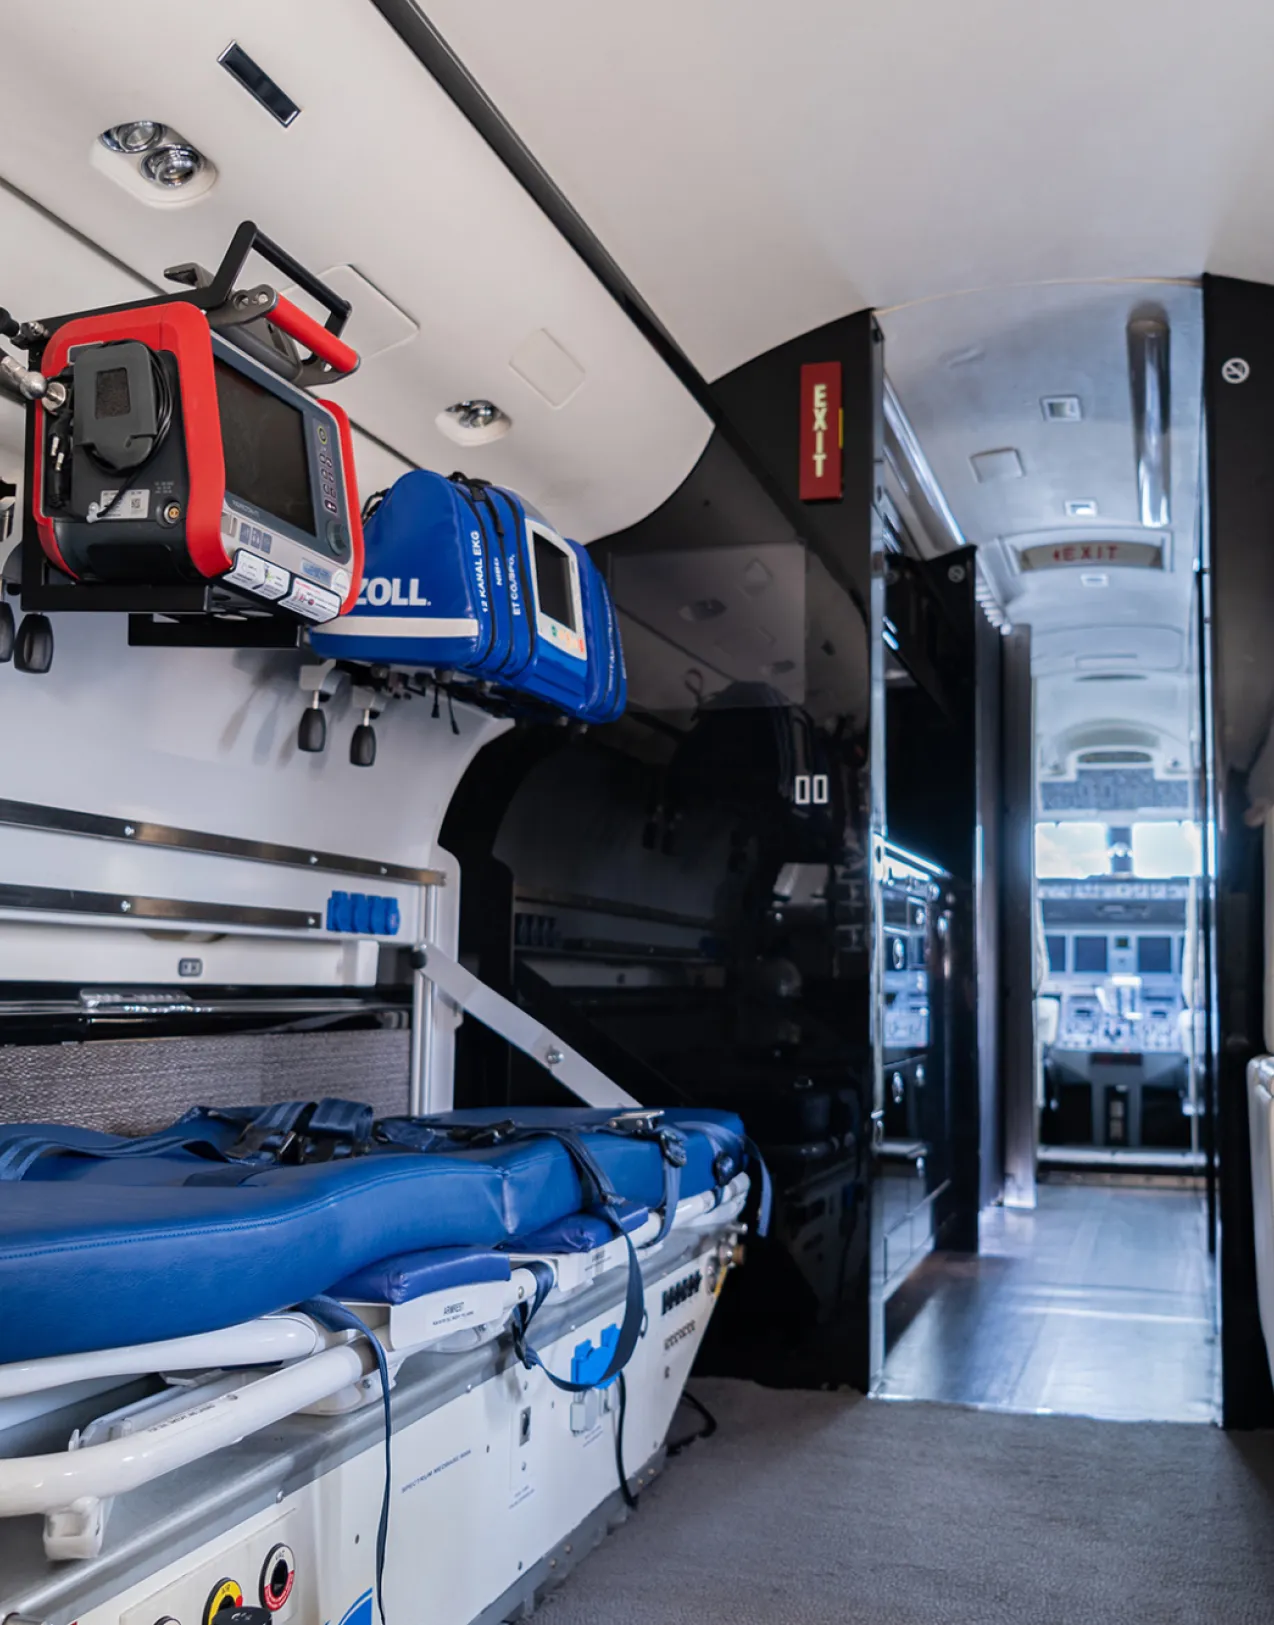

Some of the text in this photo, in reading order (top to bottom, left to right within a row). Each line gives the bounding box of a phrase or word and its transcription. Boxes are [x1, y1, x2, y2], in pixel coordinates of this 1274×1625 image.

[813, 384, 828, 478] EXIT
[1061, 544, 1118, 561] EXIT
[470, 530, 489, 613] 12 KANAL EKG
[356, 577, 427, 606] ZOLL
[511, 602, 521, 616] ET
